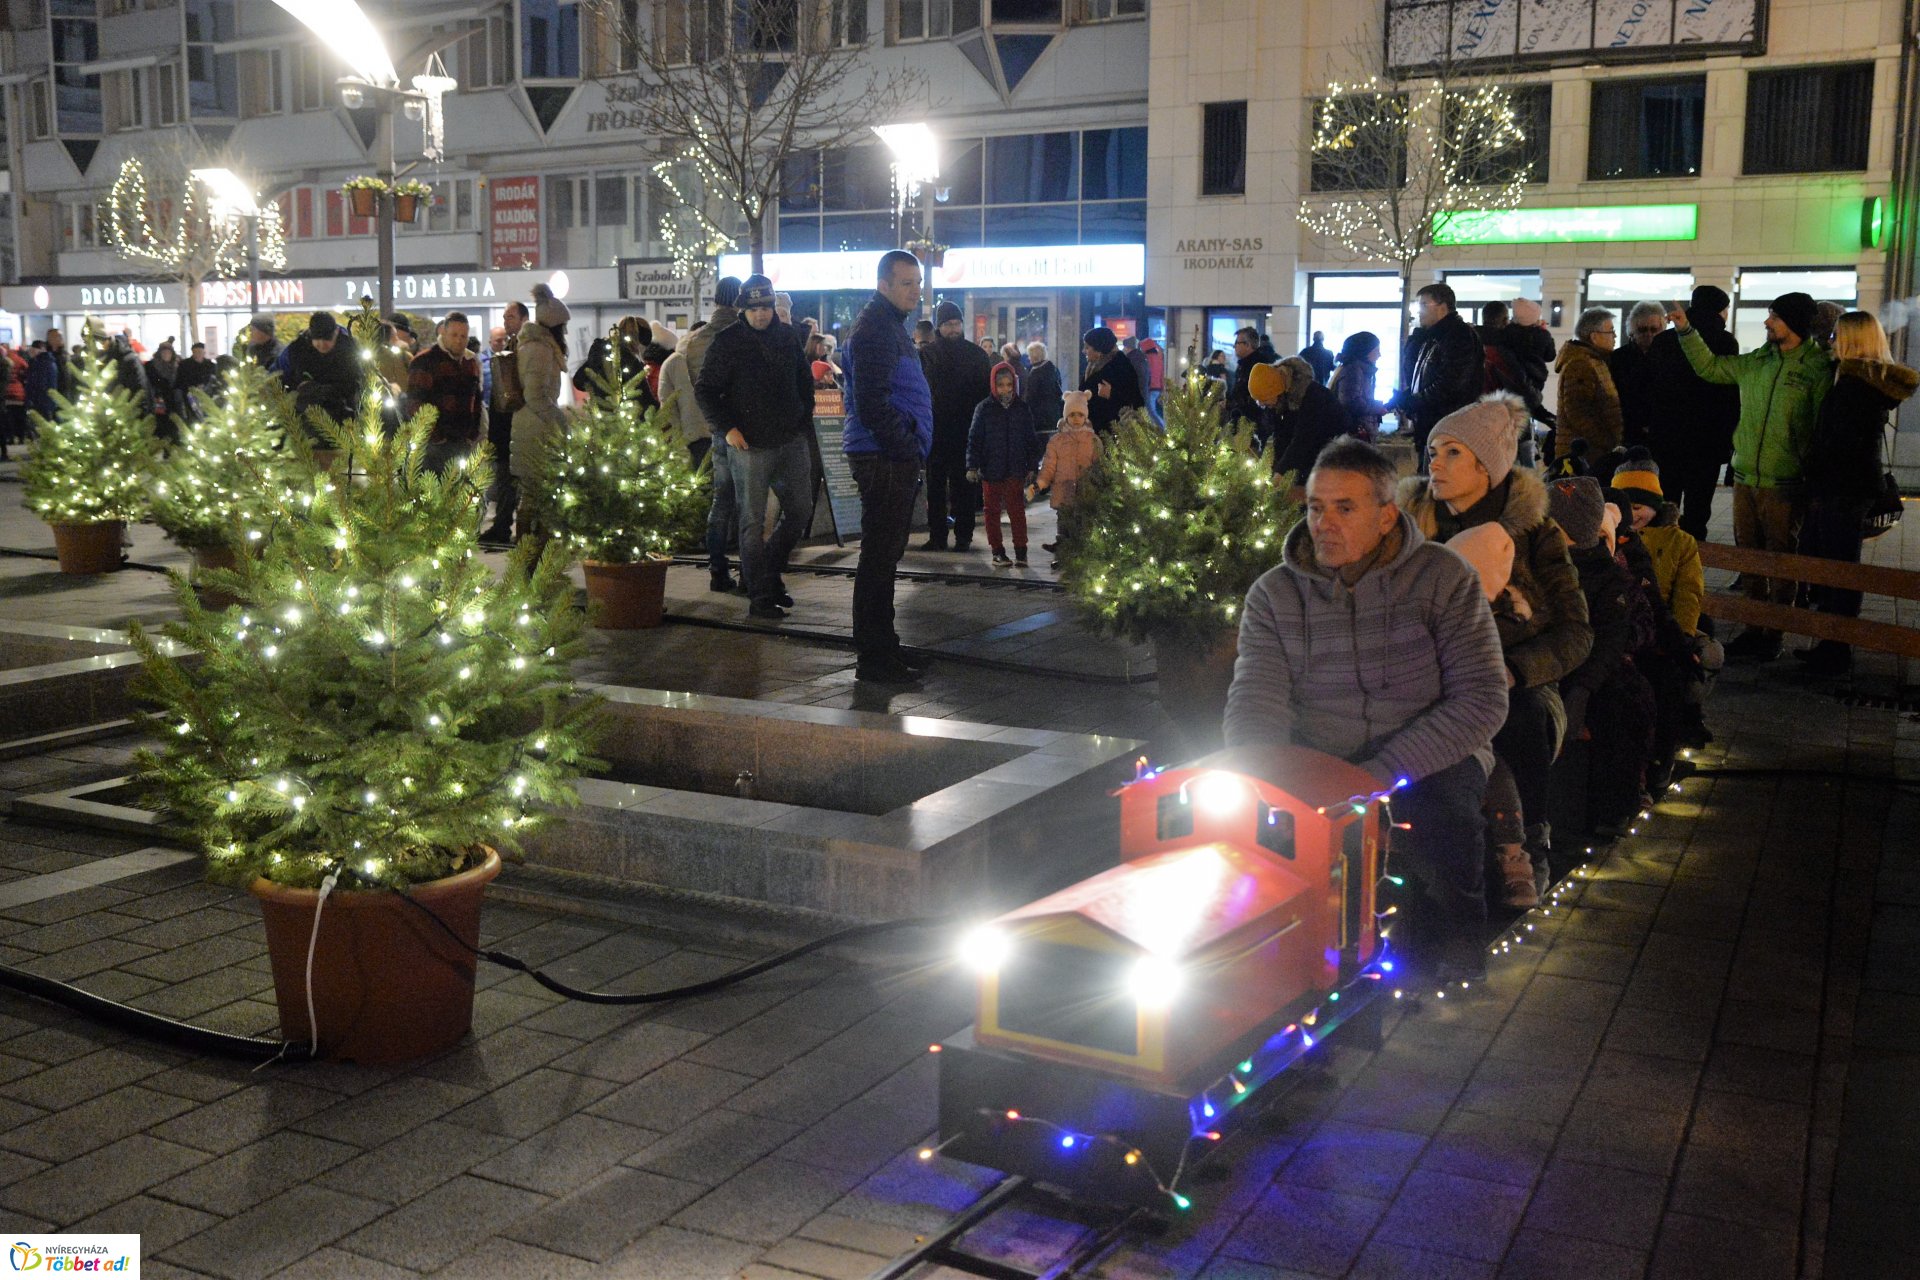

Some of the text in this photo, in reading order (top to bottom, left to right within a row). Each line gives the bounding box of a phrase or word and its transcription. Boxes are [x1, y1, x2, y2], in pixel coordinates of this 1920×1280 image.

[495, 181, 536, 201] IRODÁK
[495, 205, 537, 224] KIADÓK
[1176, 238, 1263, 252] ARANY-SAS
[1184, 254, 1254, 270] IRODAHÁZ
[81, 283, 165, 305] DROGÉRIA
[200, 279, 303, 306] ROSSMANN
[346, 273, 496, 300] PAFÜMÉRIA
[635, 282, 711, 296] IRODAH
